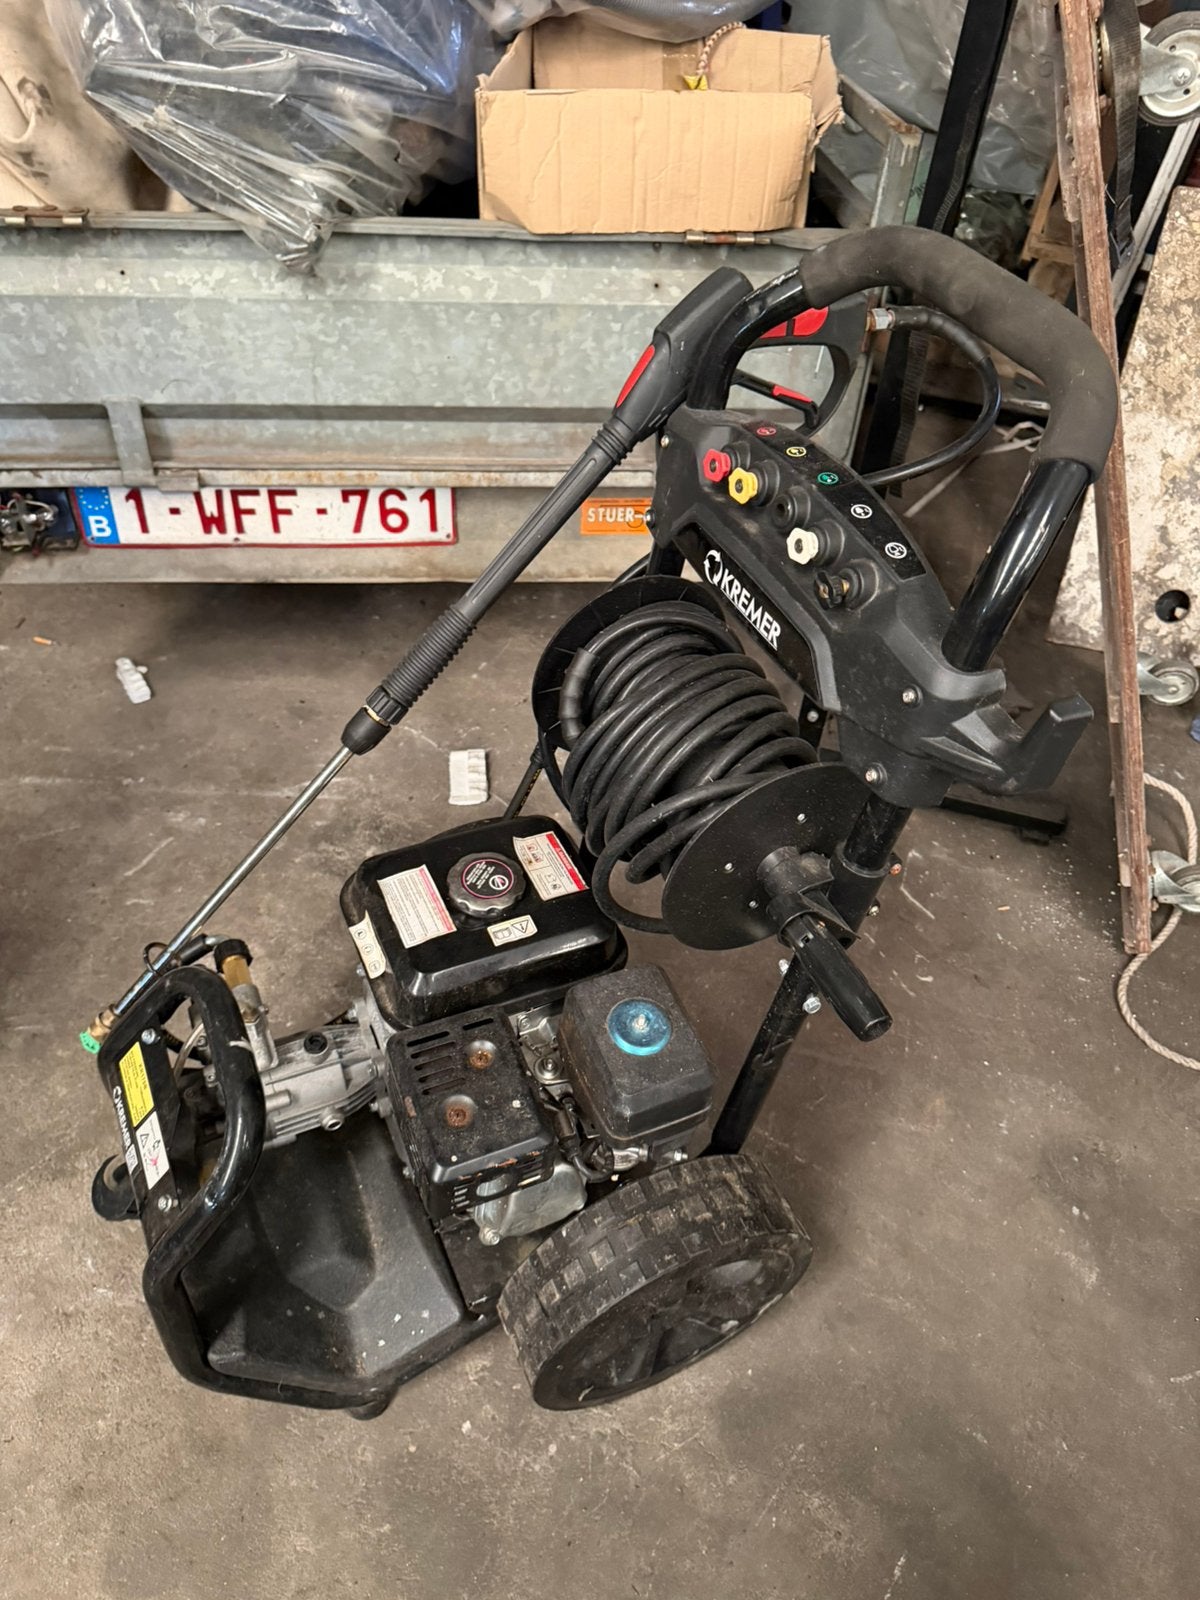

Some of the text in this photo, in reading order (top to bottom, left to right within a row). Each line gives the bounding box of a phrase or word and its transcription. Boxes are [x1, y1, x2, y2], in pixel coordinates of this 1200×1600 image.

[88, 516, 112, 537] B
[124, 487, 438, 535] 1-WFF-761
[588, 507, 651, 523] STUER-
[721, 568, 781, 650] KREMER
[116, 1100, 131, 1150] KREMER
